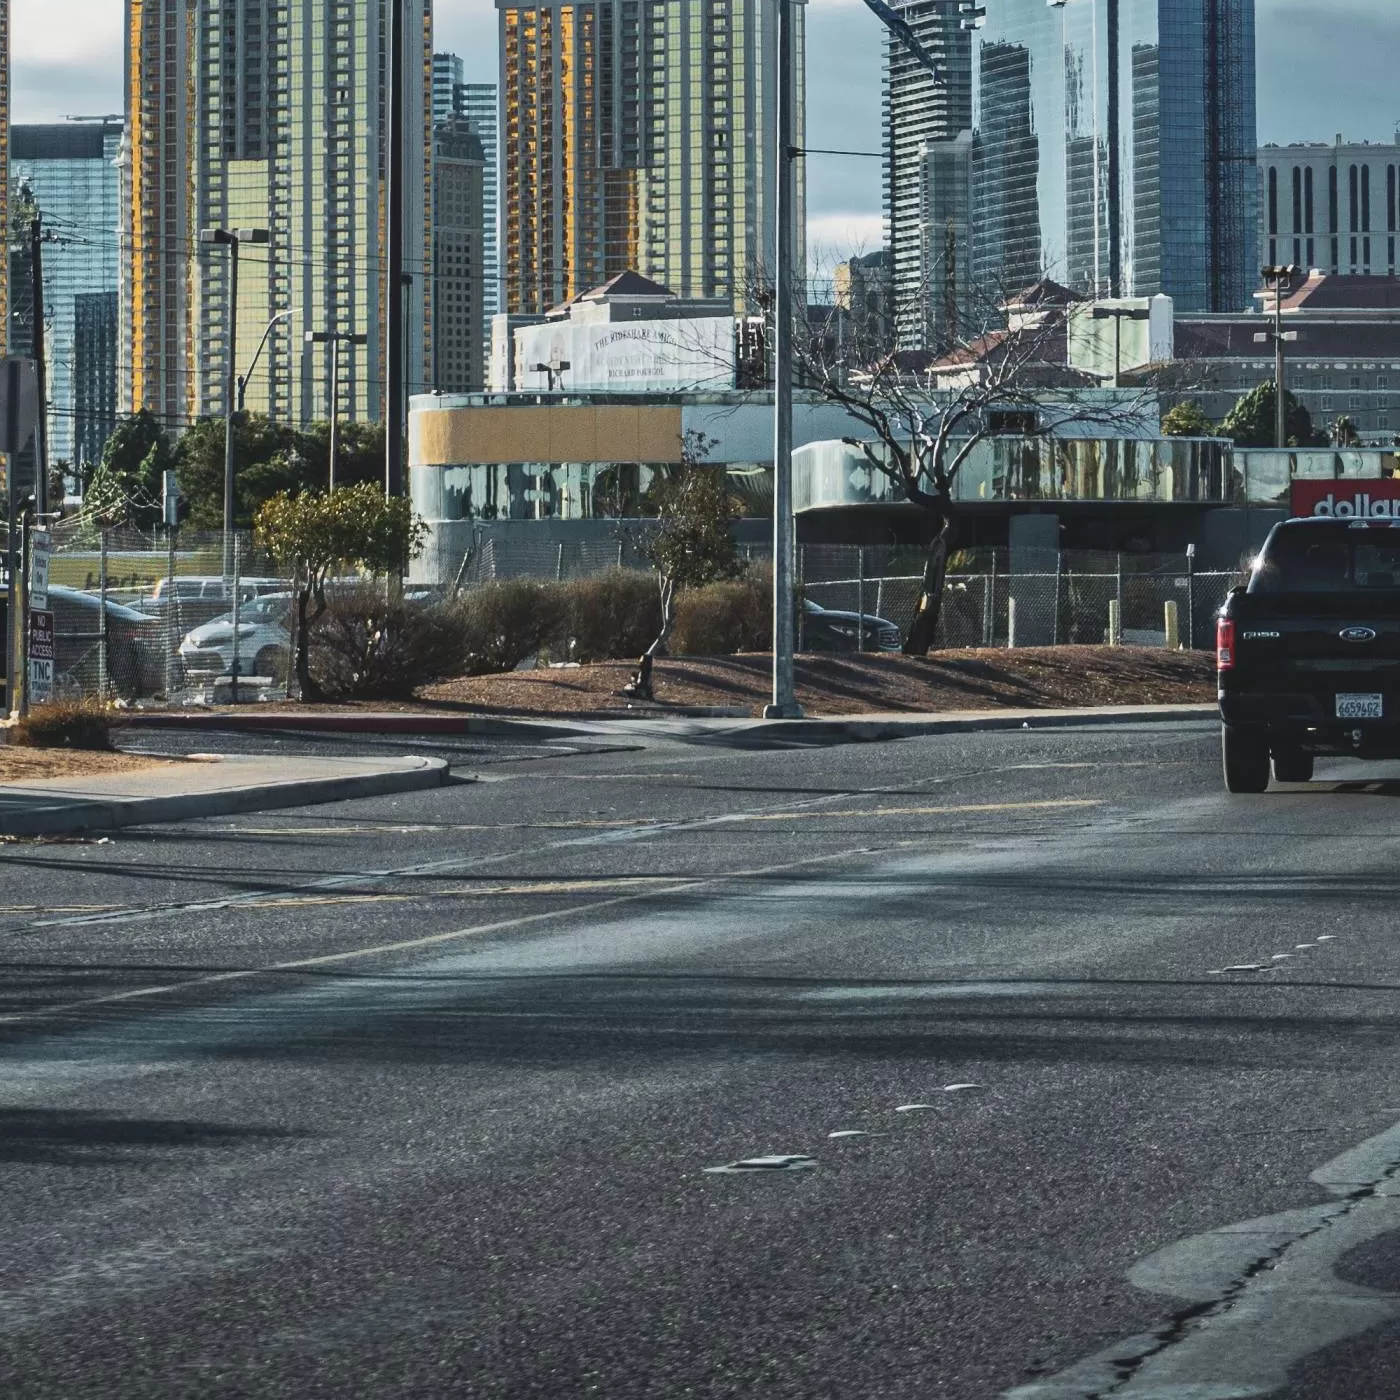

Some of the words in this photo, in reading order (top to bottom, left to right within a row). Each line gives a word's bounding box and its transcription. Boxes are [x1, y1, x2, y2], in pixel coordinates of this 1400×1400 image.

[594, 336, 610, 351] THE
[37, 615, 47, 628] NO
[32, 628, 53, 643] PUBLIC
[31, 644, 54, 658] ACCESS
[33, 661, 51, 681] TNC
